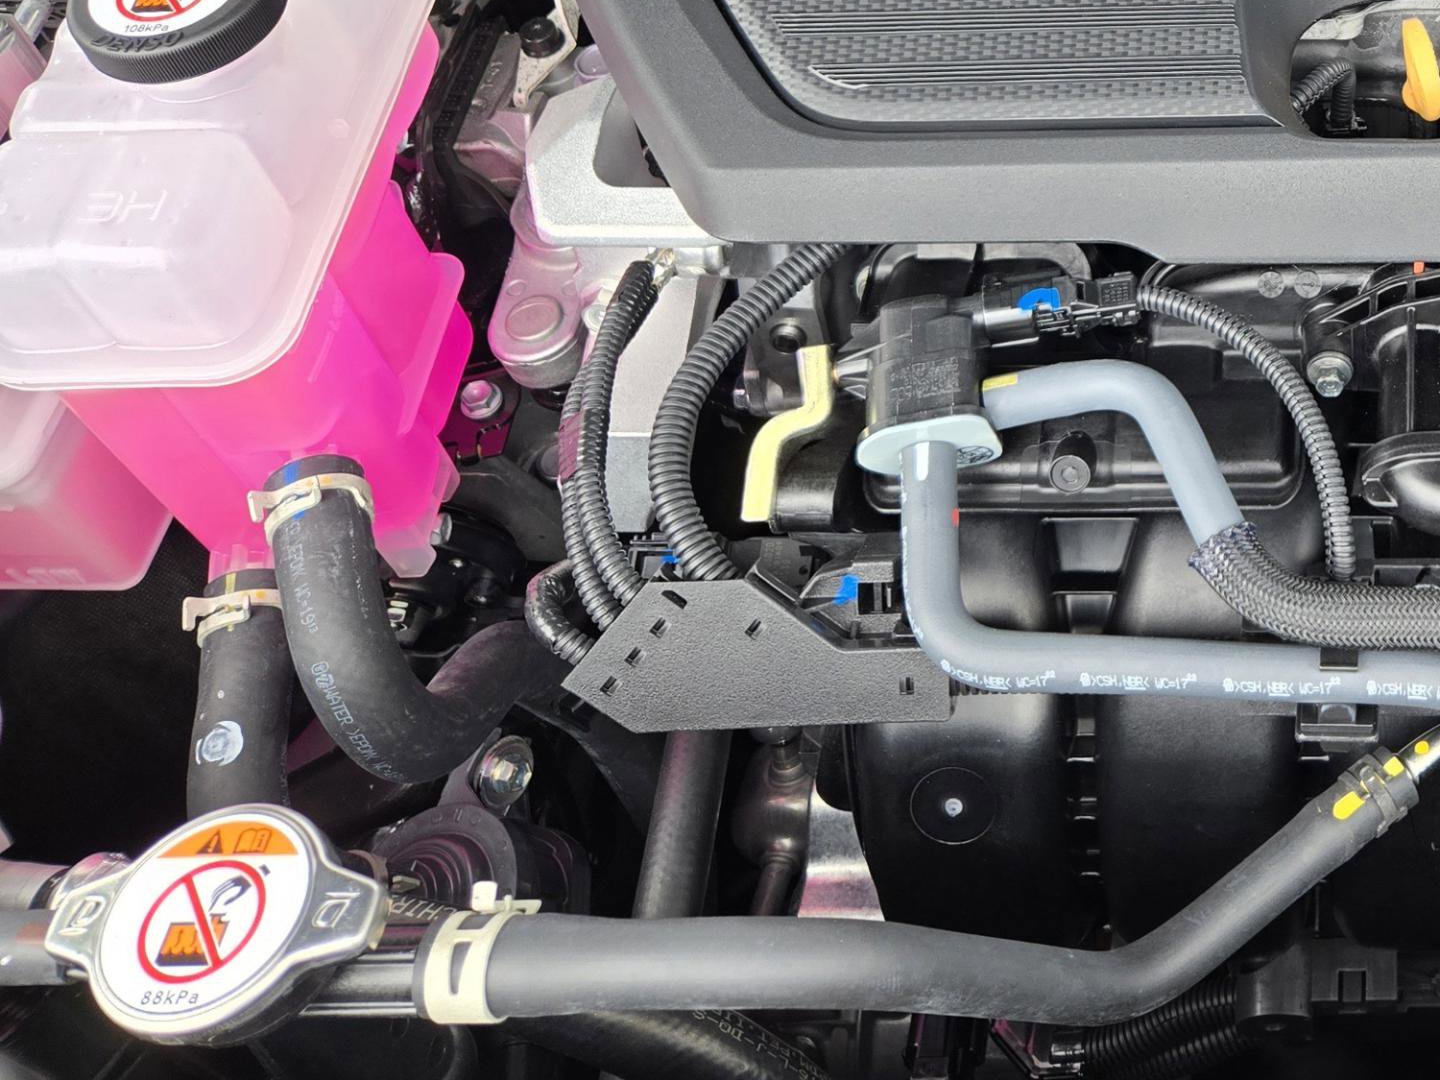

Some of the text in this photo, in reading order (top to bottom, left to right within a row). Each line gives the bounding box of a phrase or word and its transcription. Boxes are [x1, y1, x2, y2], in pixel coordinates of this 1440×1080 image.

[124, 23, 170, 33] 108kPa
[91, 31, 185, 52] DENSO
[141, 990, 199, 1005] 88kPa
